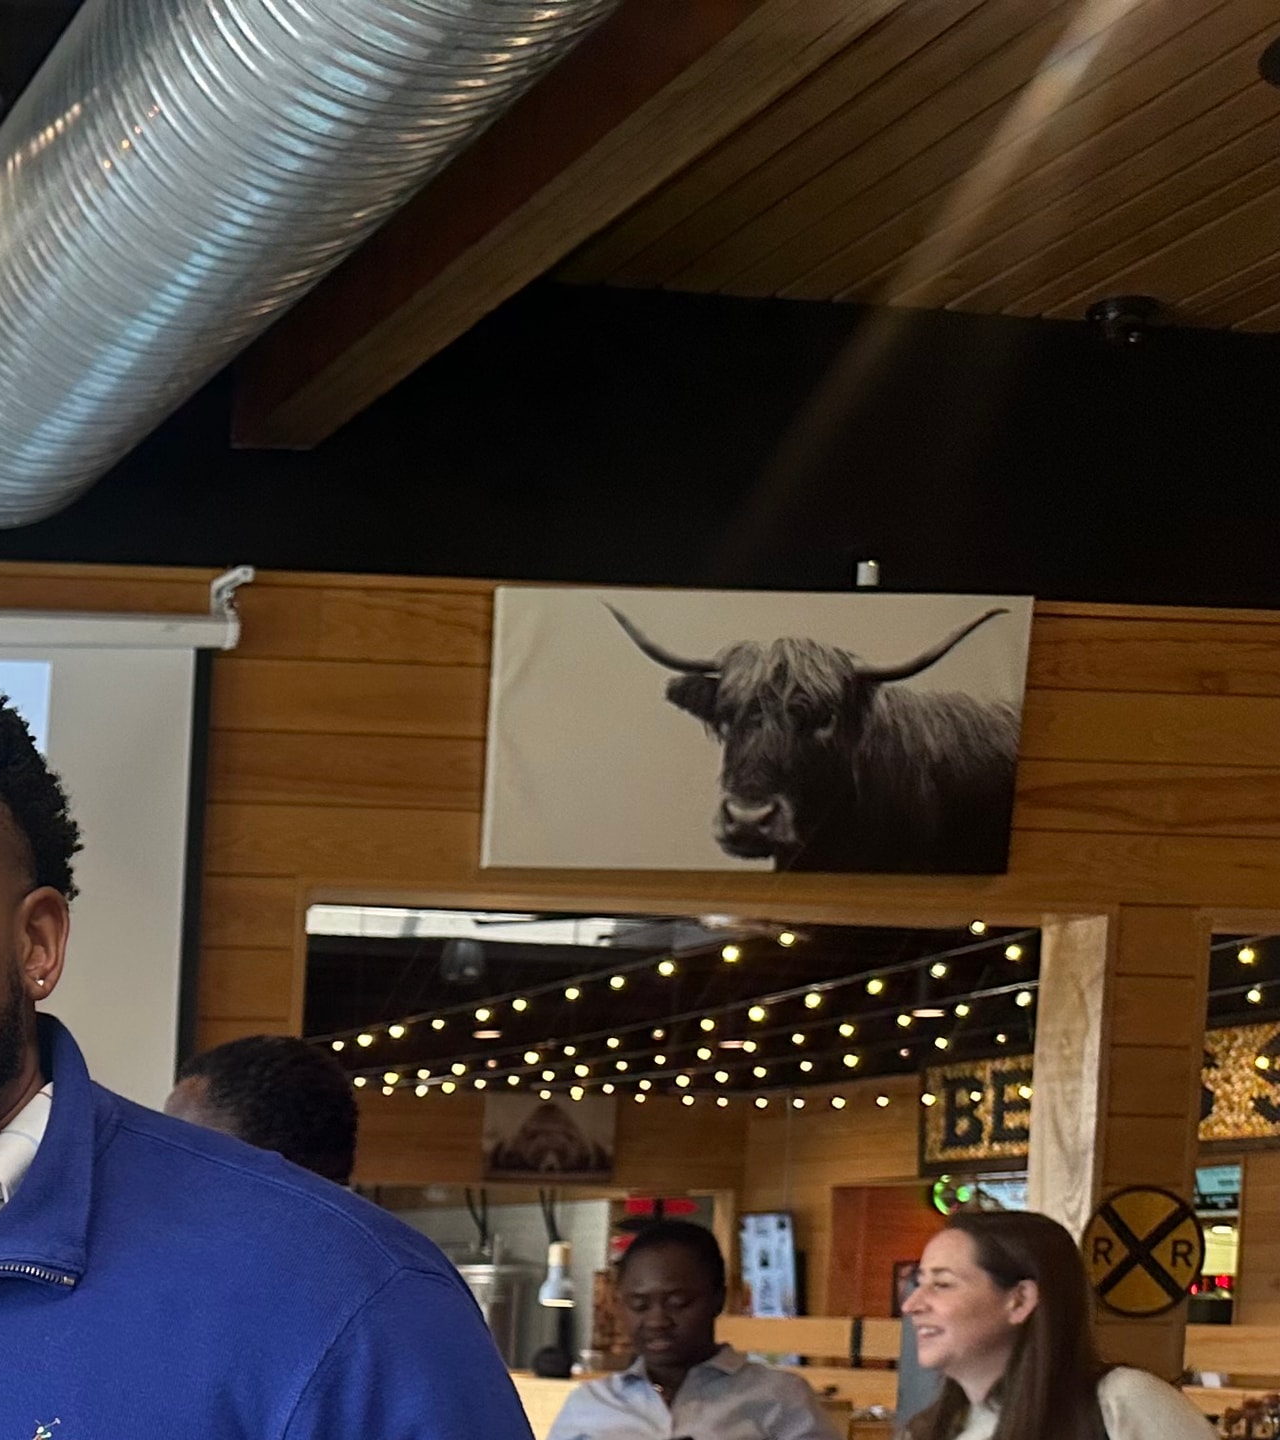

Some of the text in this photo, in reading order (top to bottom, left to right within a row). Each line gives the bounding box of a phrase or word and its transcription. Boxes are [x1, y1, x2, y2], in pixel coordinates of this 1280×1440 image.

[943, 1069, 1033, 1147] BE
[1092, 1237, 1193, 1268] R R
